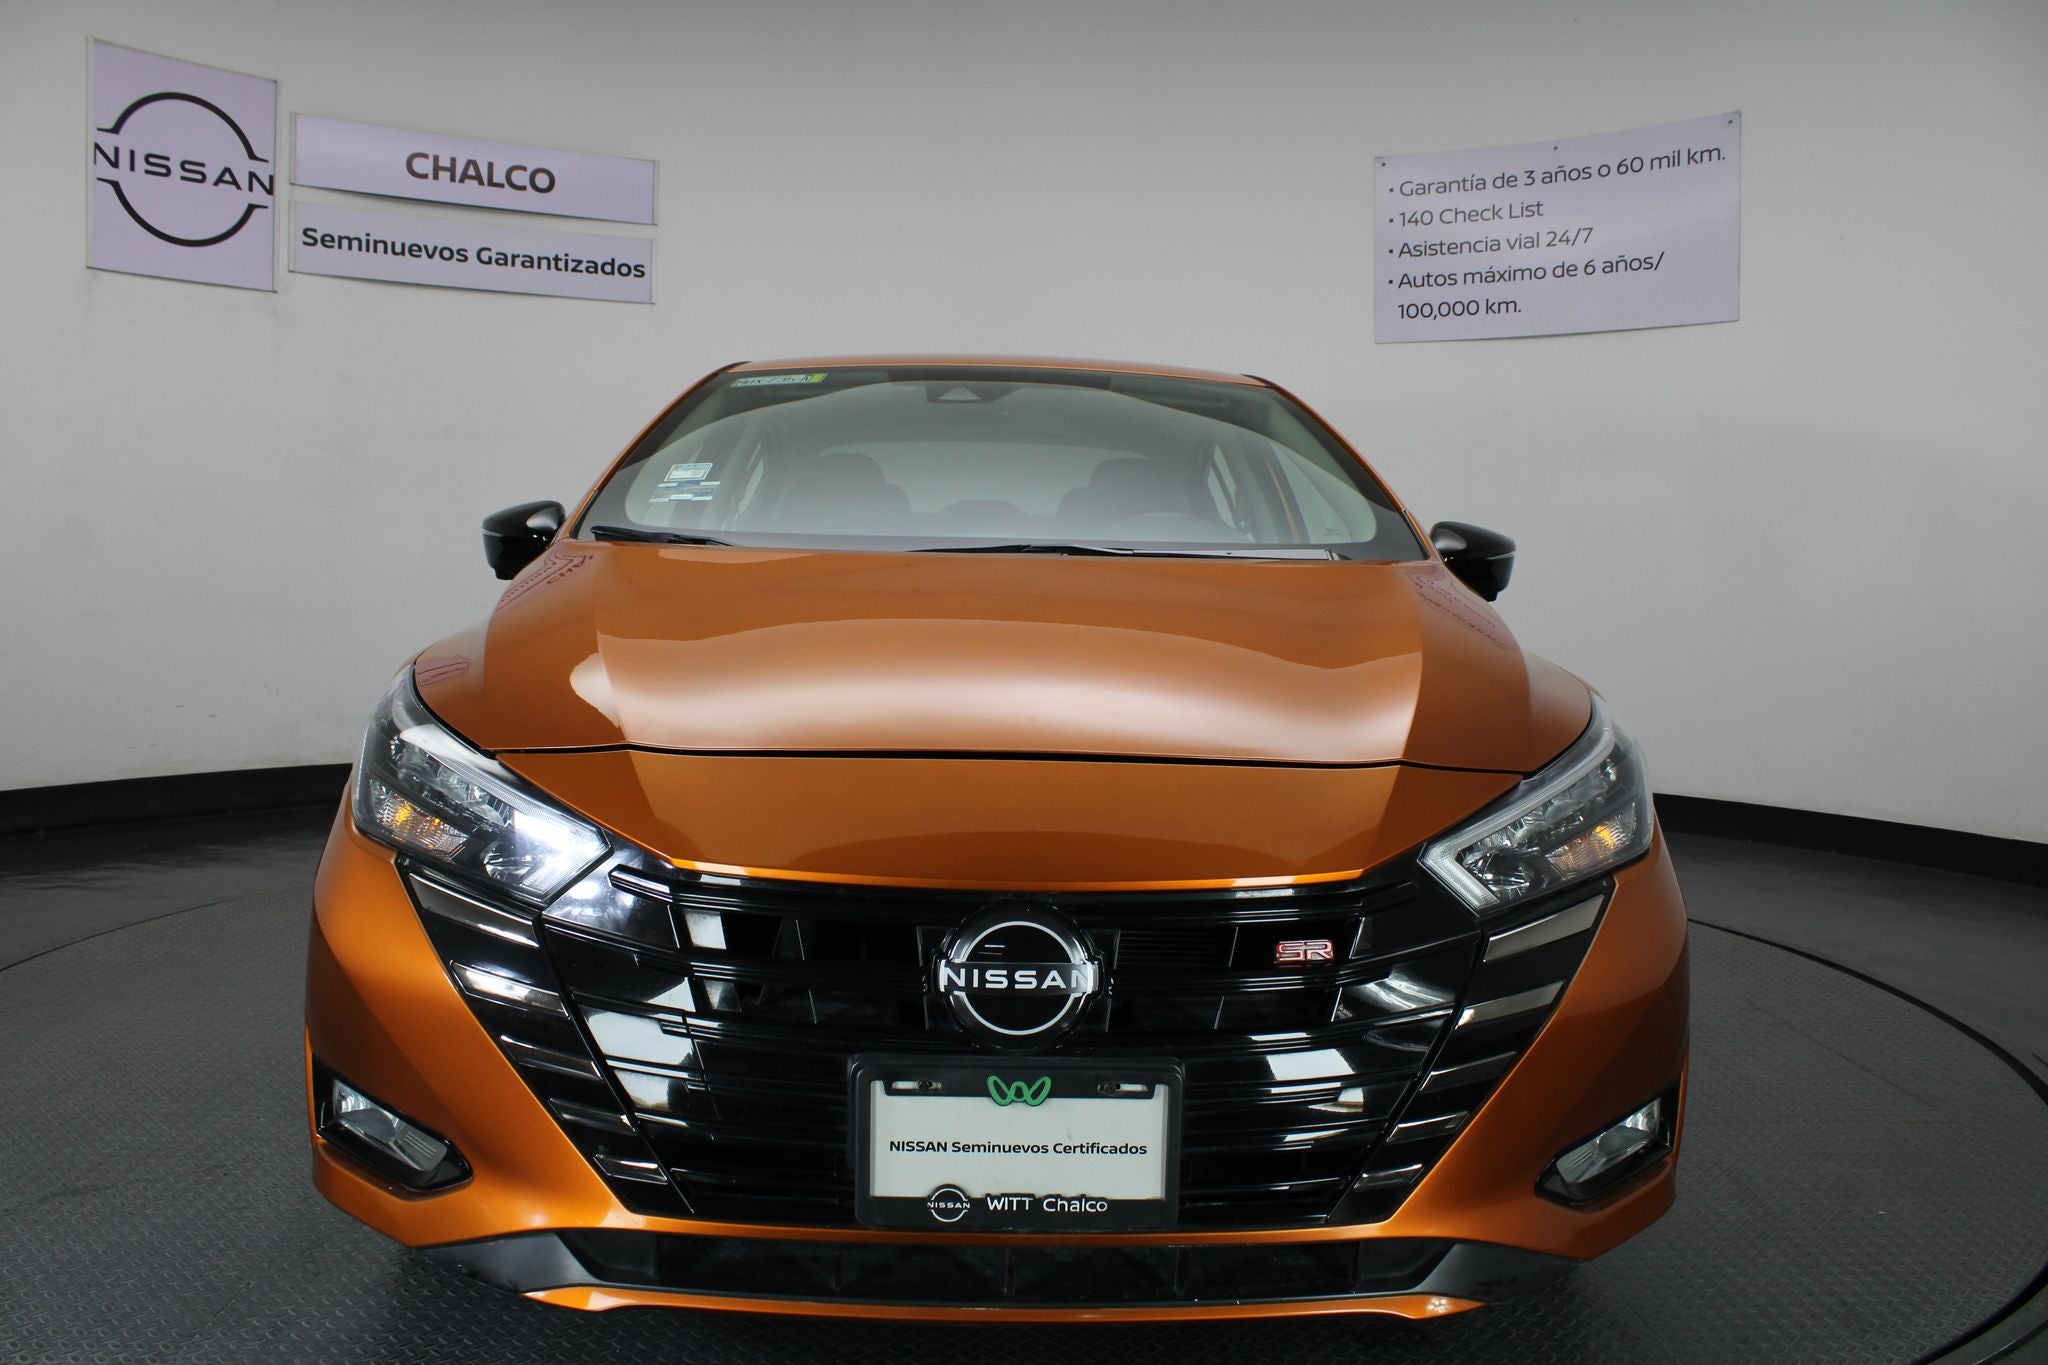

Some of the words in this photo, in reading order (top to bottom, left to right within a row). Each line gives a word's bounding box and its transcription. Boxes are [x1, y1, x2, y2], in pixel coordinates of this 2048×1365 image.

[93, 141, 274, 196] NISSAN
[405, 151, 556, 195] CHALCO
[1399, 173, 1487, 197] Garantía
[1491, 171, 1519, 189] de
[1523, 169, 1536, 187] 3
[1540, 164, 1593, 185] años
[1597, 163, 1612, 178] o
[1616, 156, 1645, 176] 60
[1649, 148, 1682, 172] mil
[1687, 146, 1726, 166] km.
[1399, 209, 1434, 228] 140
[1438, 203, 1504, 225] Check
[1508, 200, 1545, 220] List
[301, 226, 470, 264] Seminuevos
[475, 246, 646, 279] Garantizados
[1398, 236, 1501, 259] Asistencia
[1505, 231, 1541, 251] vial
[1545, 226, 1594, 248] 24/7
[1397, 272, 1459, 290] Autos
[1463, 265, 1548, 287] máximo
[1551, 260, 1579, 279] de
[1583, 258, 1597, 276] 6
[1601, 250, 1666, 276] años/
[1397, 299, 1480, 322] 100,000
[1485, 297, 1523, 316] km.
[1276, 939, 1334, 961] SR
[944, 966, 1091, 990] NISSAN
[889, 1140, 948, 1153] NISSAN
[951, 1140, 1050, 1155] Seminuevos
[1052, 1141, 1148, 1156] Certificados
[927, 1201, 971, 1209] NISSAN
[986, 1196, 1035, 1212] WITT
[1043, 1197, 1108, 1213] Chalco
